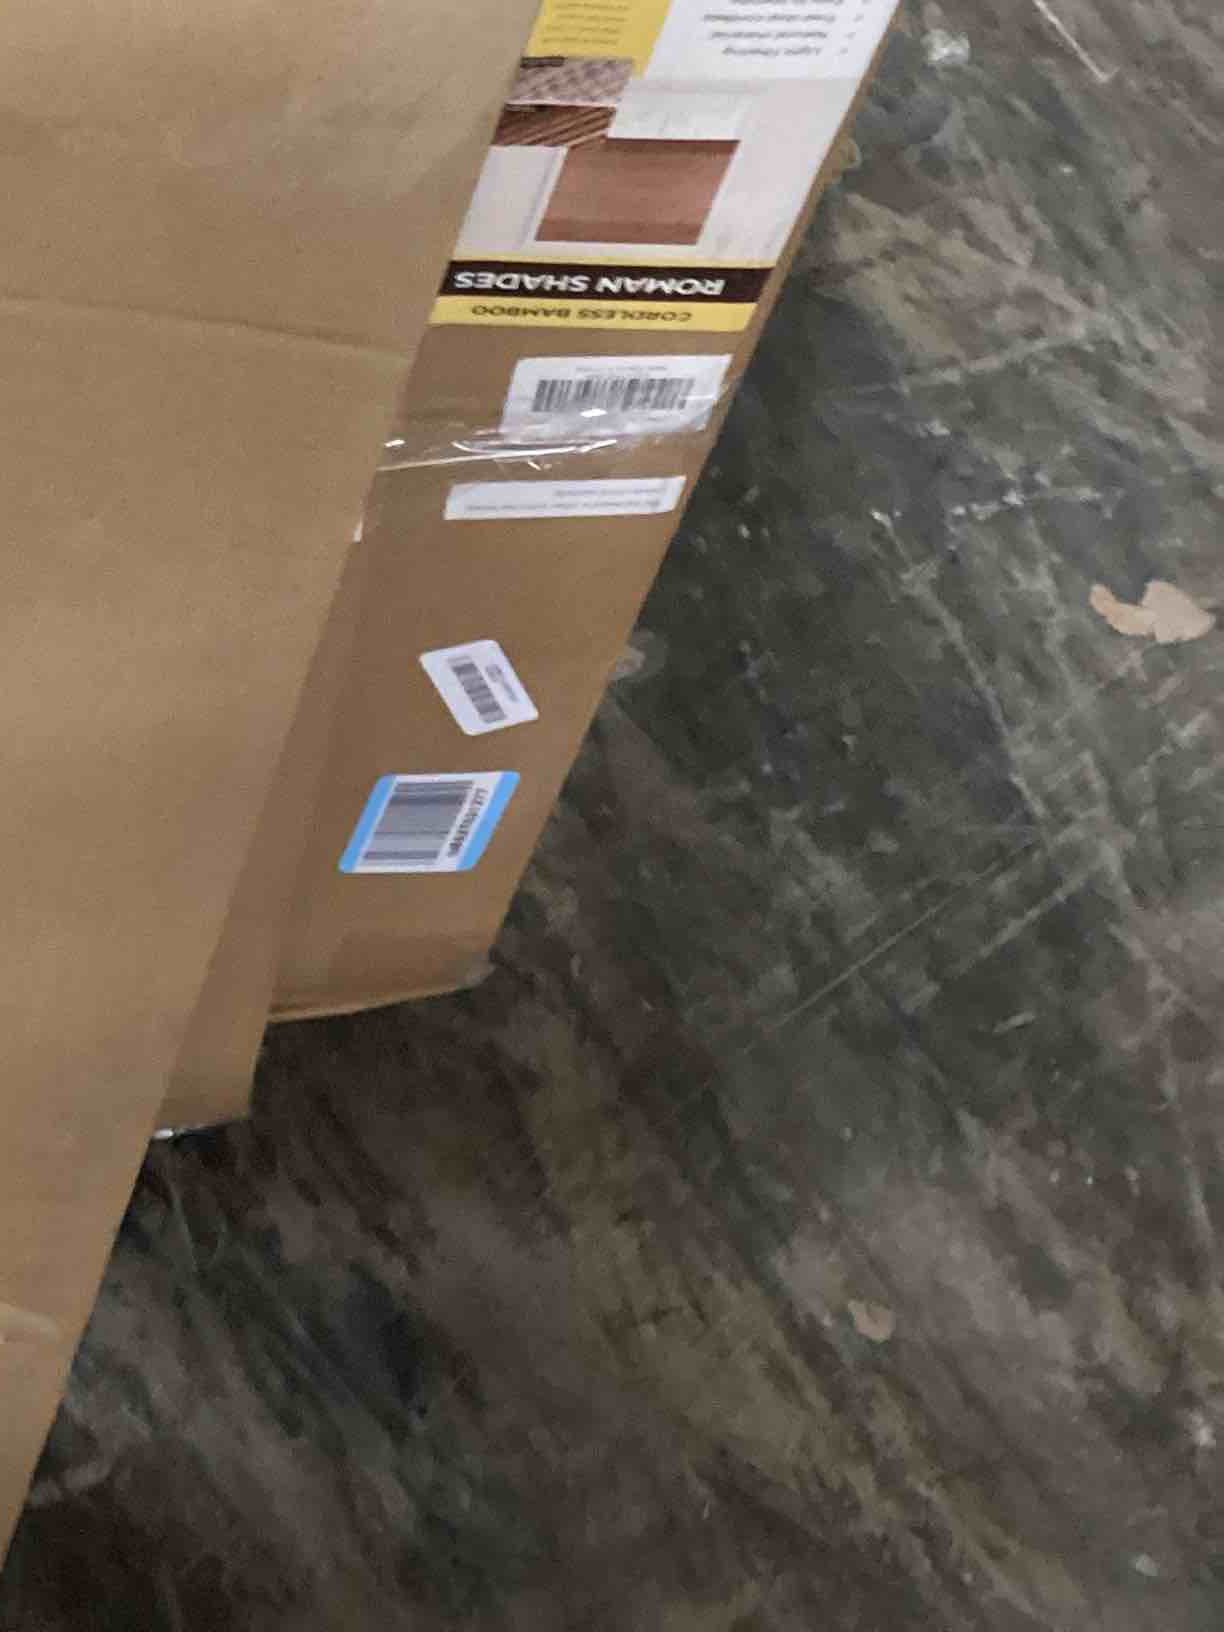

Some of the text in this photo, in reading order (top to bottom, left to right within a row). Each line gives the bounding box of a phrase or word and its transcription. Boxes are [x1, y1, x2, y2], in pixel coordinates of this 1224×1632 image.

[453, 270, 726, 297] ROMAN SHADES
[471, 304, 693, 322] CORDLESS BAMBOO
